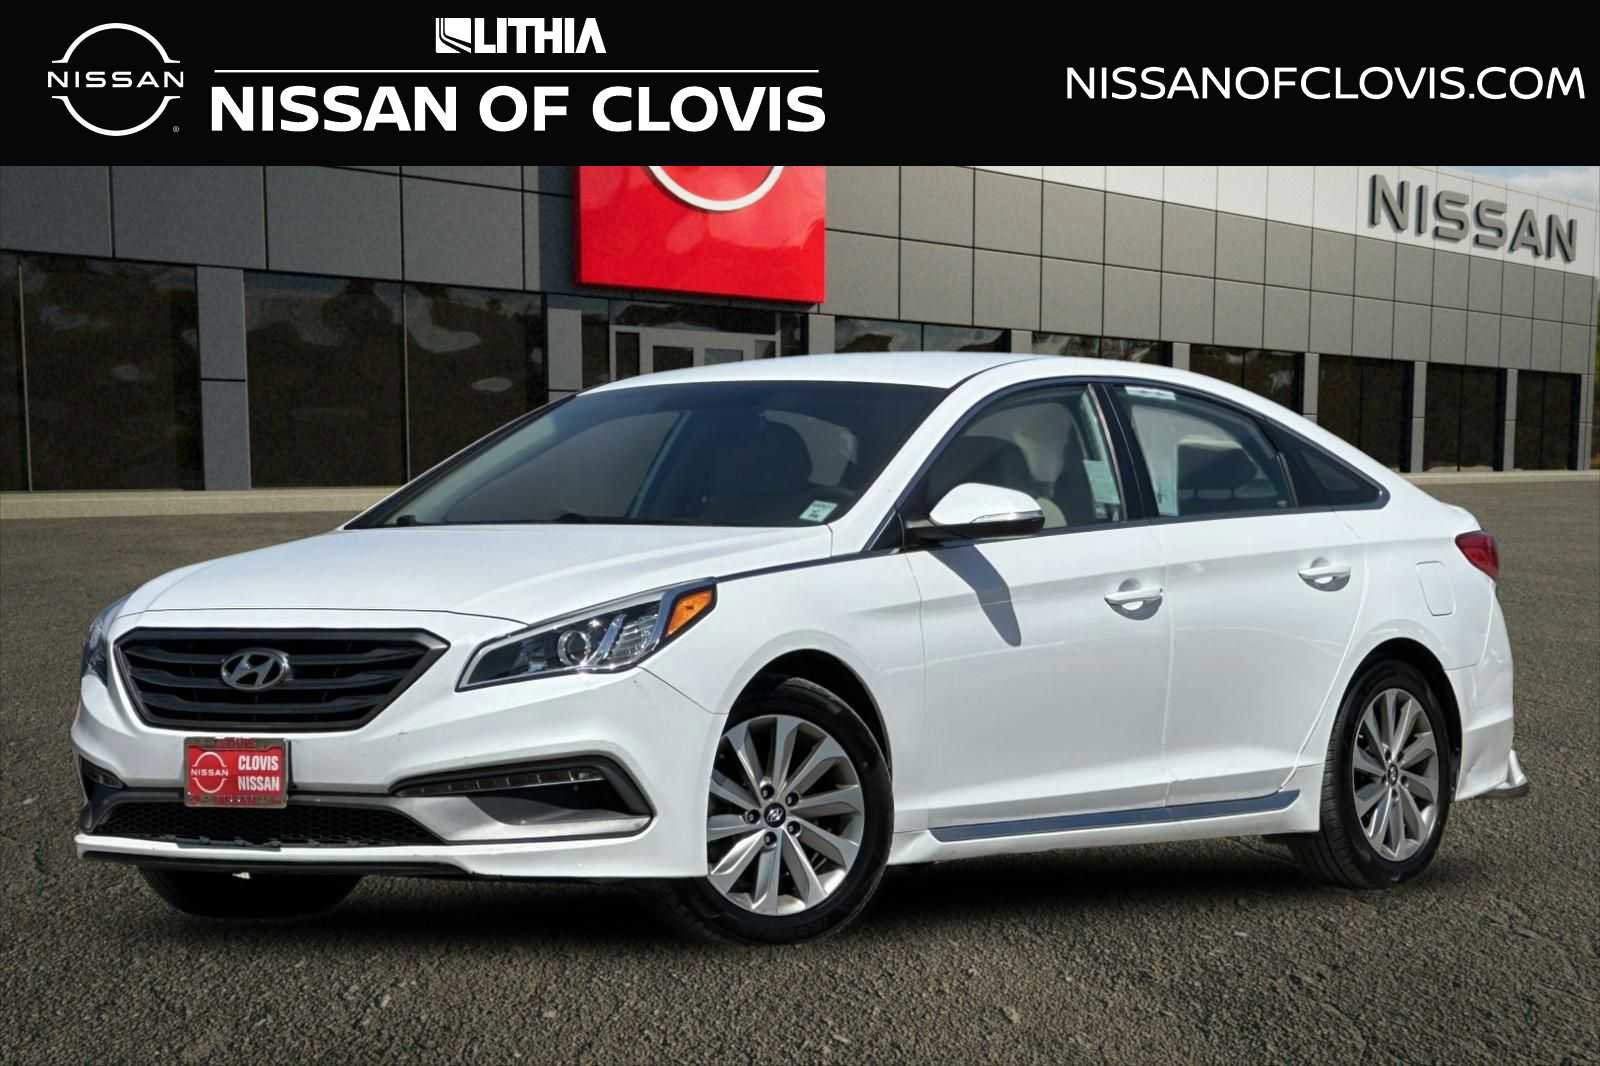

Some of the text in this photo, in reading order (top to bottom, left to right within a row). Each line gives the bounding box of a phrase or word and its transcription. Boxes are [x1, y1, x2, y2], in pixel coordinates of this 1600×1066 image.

[1368, 174, 1577, 263] NISSAN
[237, 755, 279, 772] CLOVIS
[191, 768, 229, 777] NISSAN
[237, 775, 280, 792] NISSAN
